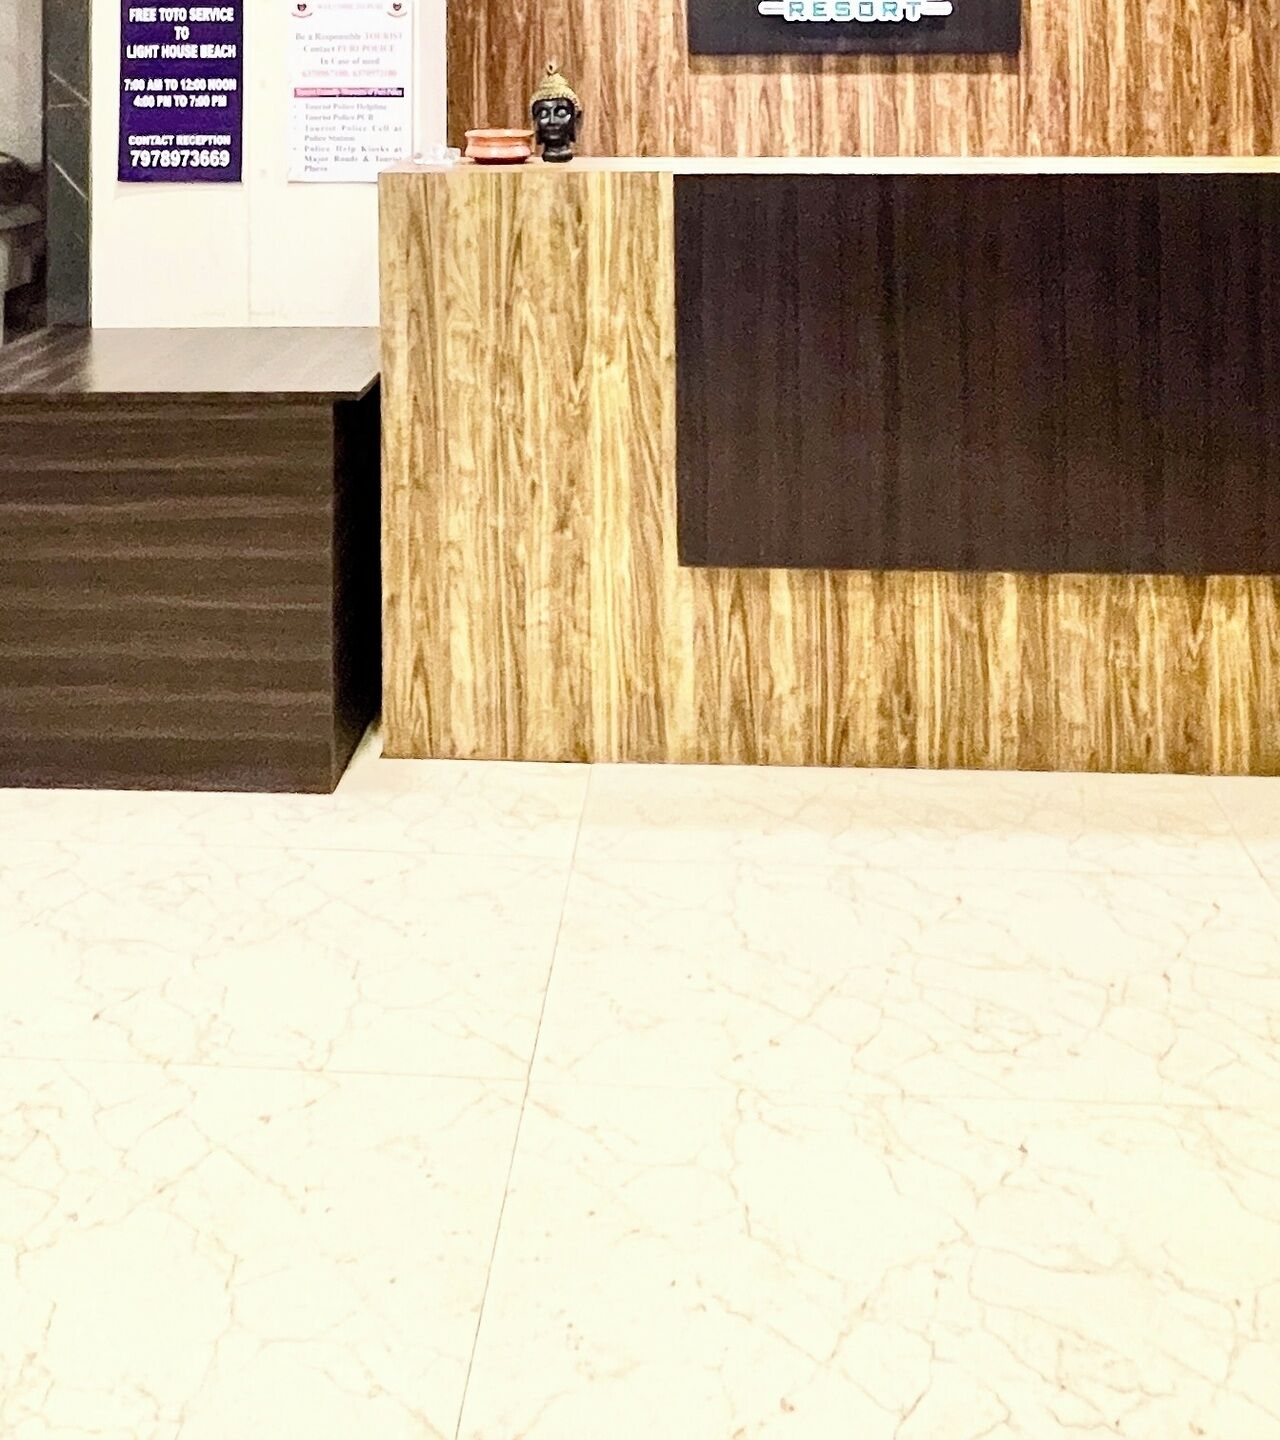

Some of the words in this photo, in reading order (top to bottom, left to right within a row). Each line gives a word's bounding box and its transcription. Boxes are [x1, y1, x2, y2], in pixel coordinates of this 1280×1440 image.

[129, 7, 157, 23] FREE
[159, 7, 187, 23] TOTO
[189, 7, 234, 23] SERVICE
[788, 0, 922, 18] RESORT
[174, 26, 190, 41] TO
[126, 44, 160, 59] LIGHT
[161, 44, 199, 59] HOUSE
[199, 44, 237, 59] BEACH
[146, 78, 164, 91] AM
[164, 78, 179, 91] TO
[208, 78, 237, 91] NOON
[156, 95, 172, 108] PM
[173, 95, 188, 108] TO
[212, 95, 227, 108] PM
[128, 135, 175, 147] CONTACT
[176, 135, 231, 147] RECEPTION
[130, 149, 230, 167] 7978973669
